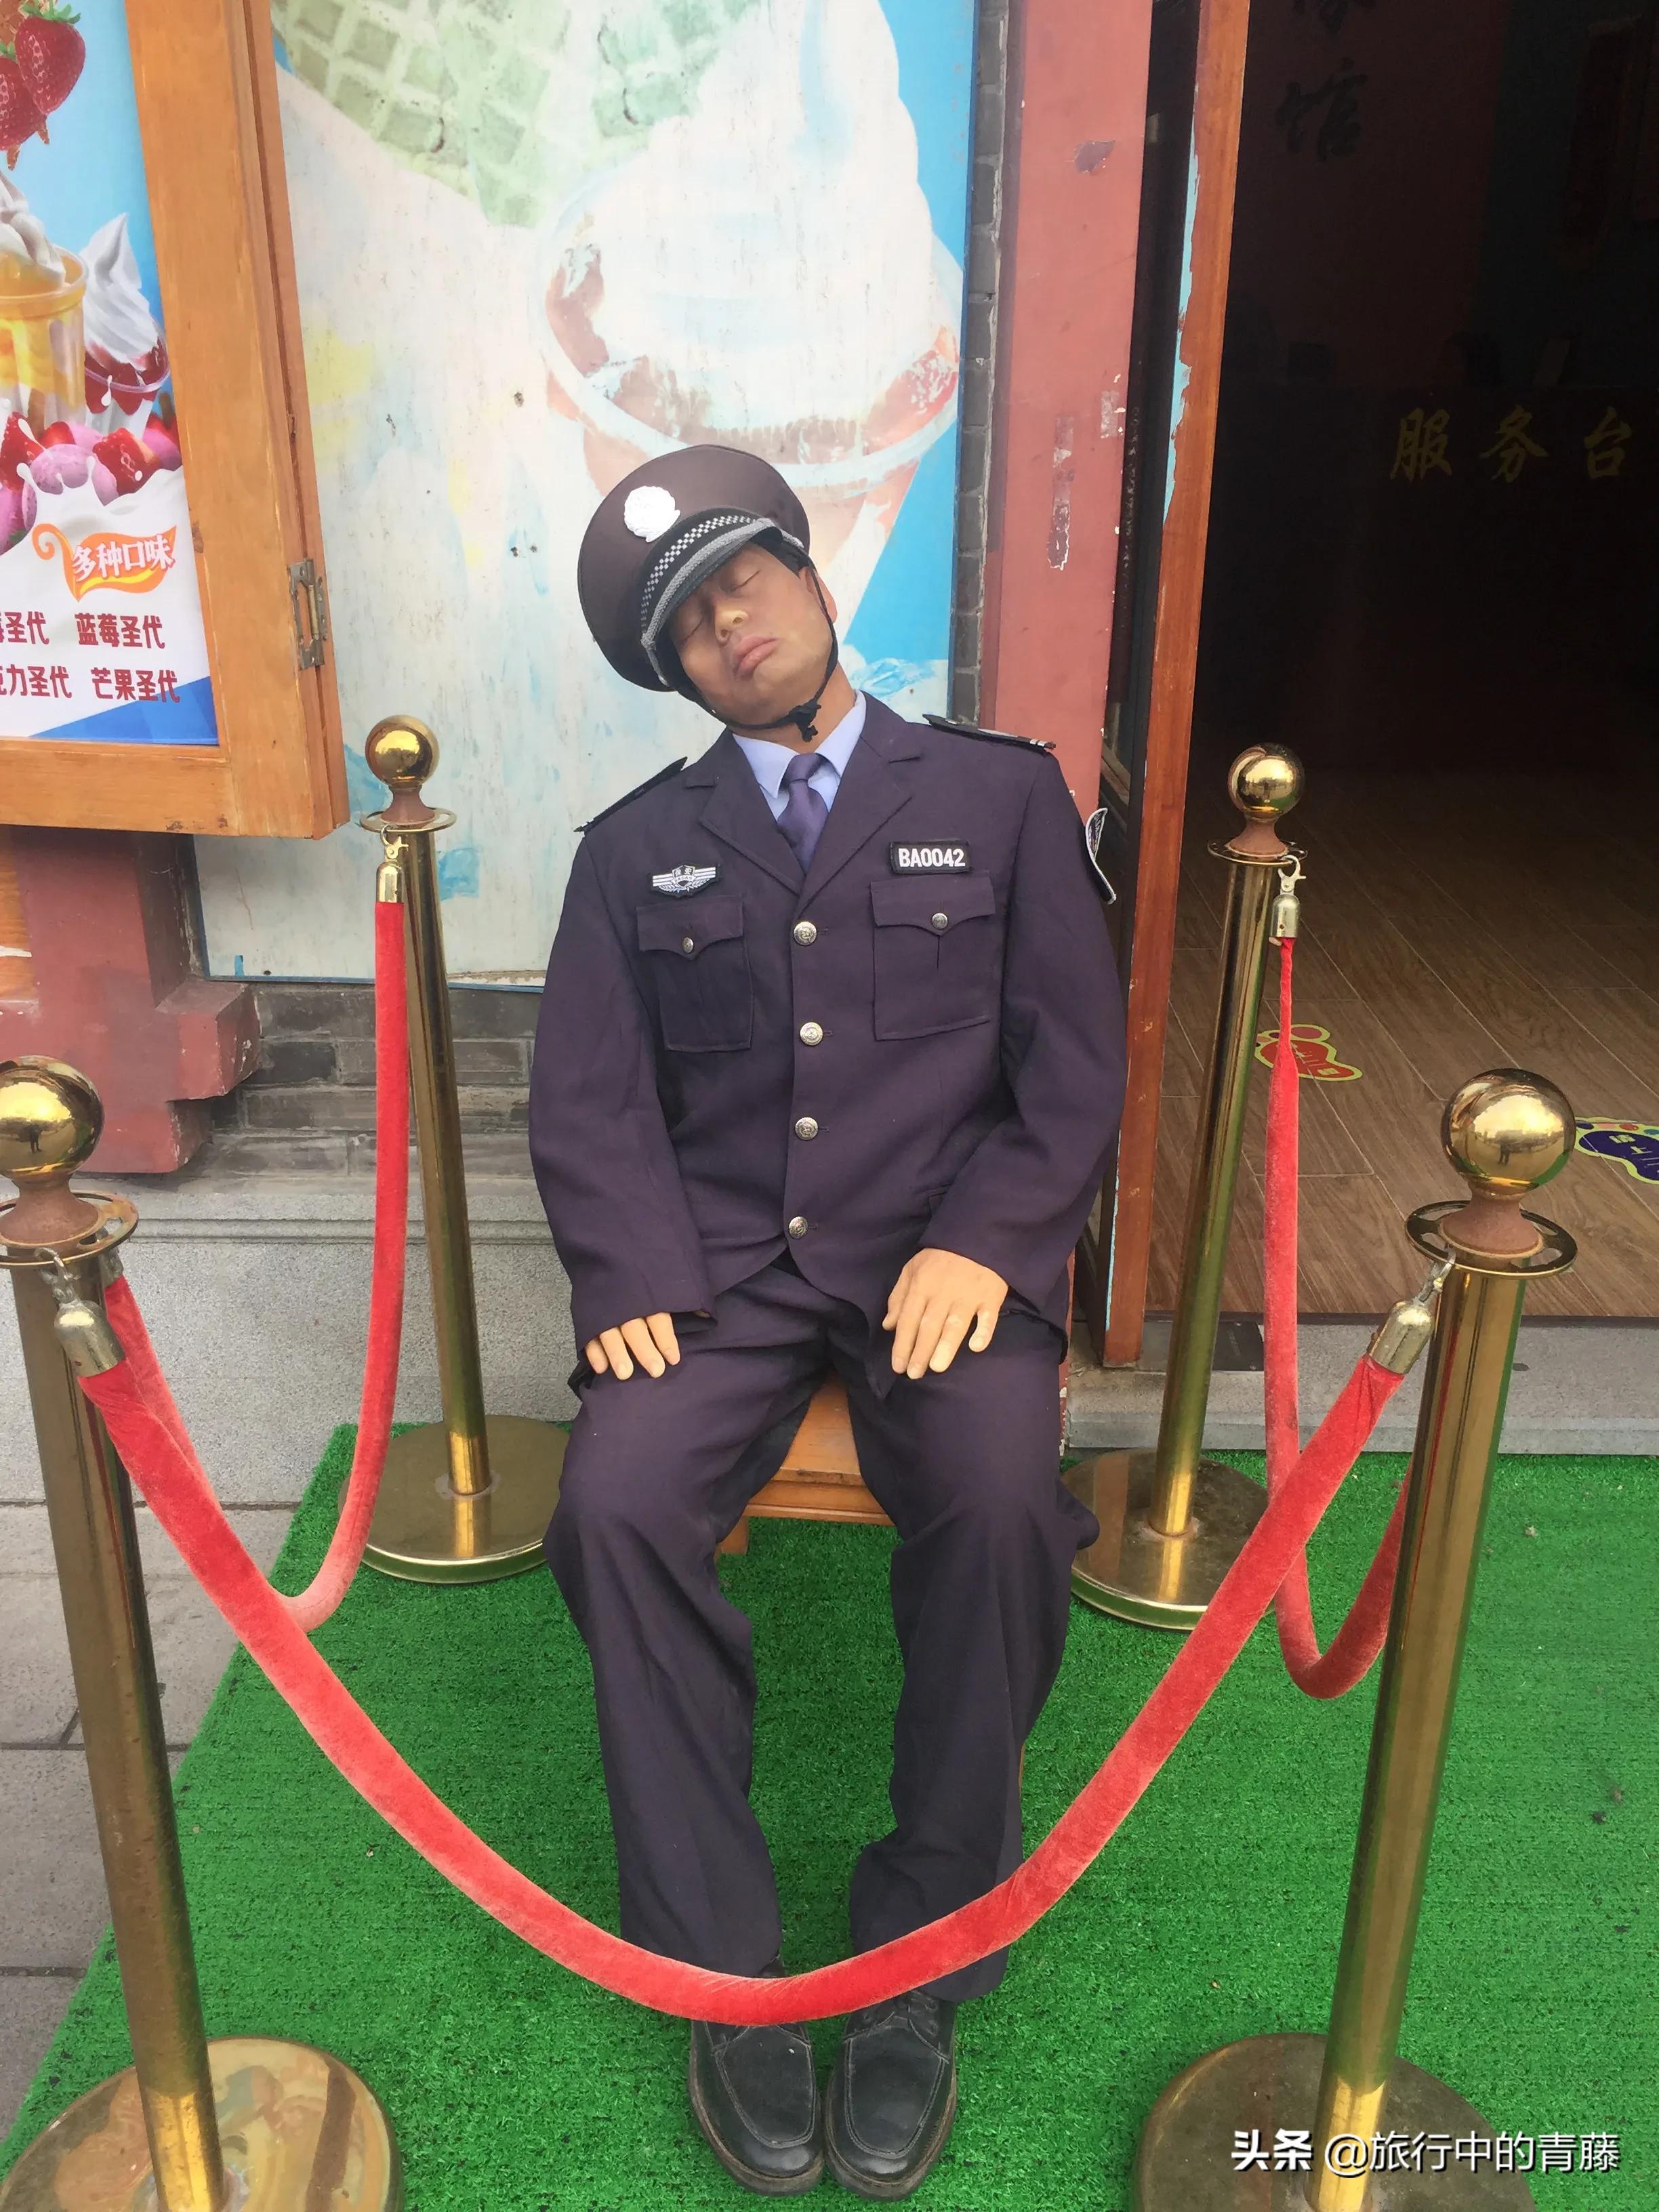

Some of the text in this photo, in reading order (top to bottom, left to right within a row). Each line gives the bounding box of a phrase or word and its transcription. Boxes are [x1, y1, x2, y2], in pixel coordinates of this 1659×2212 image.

[1390, 405, 1633, 483] 服务台
[72, 533, 174, 581] 多种口味
[0, 611, 49, 644] 圣代
[75, 613, 165, 649] 蓝莓圣代
[91, 667, 180, 703] 芒果圣代
[899, 848, 966, 867] BA0042
